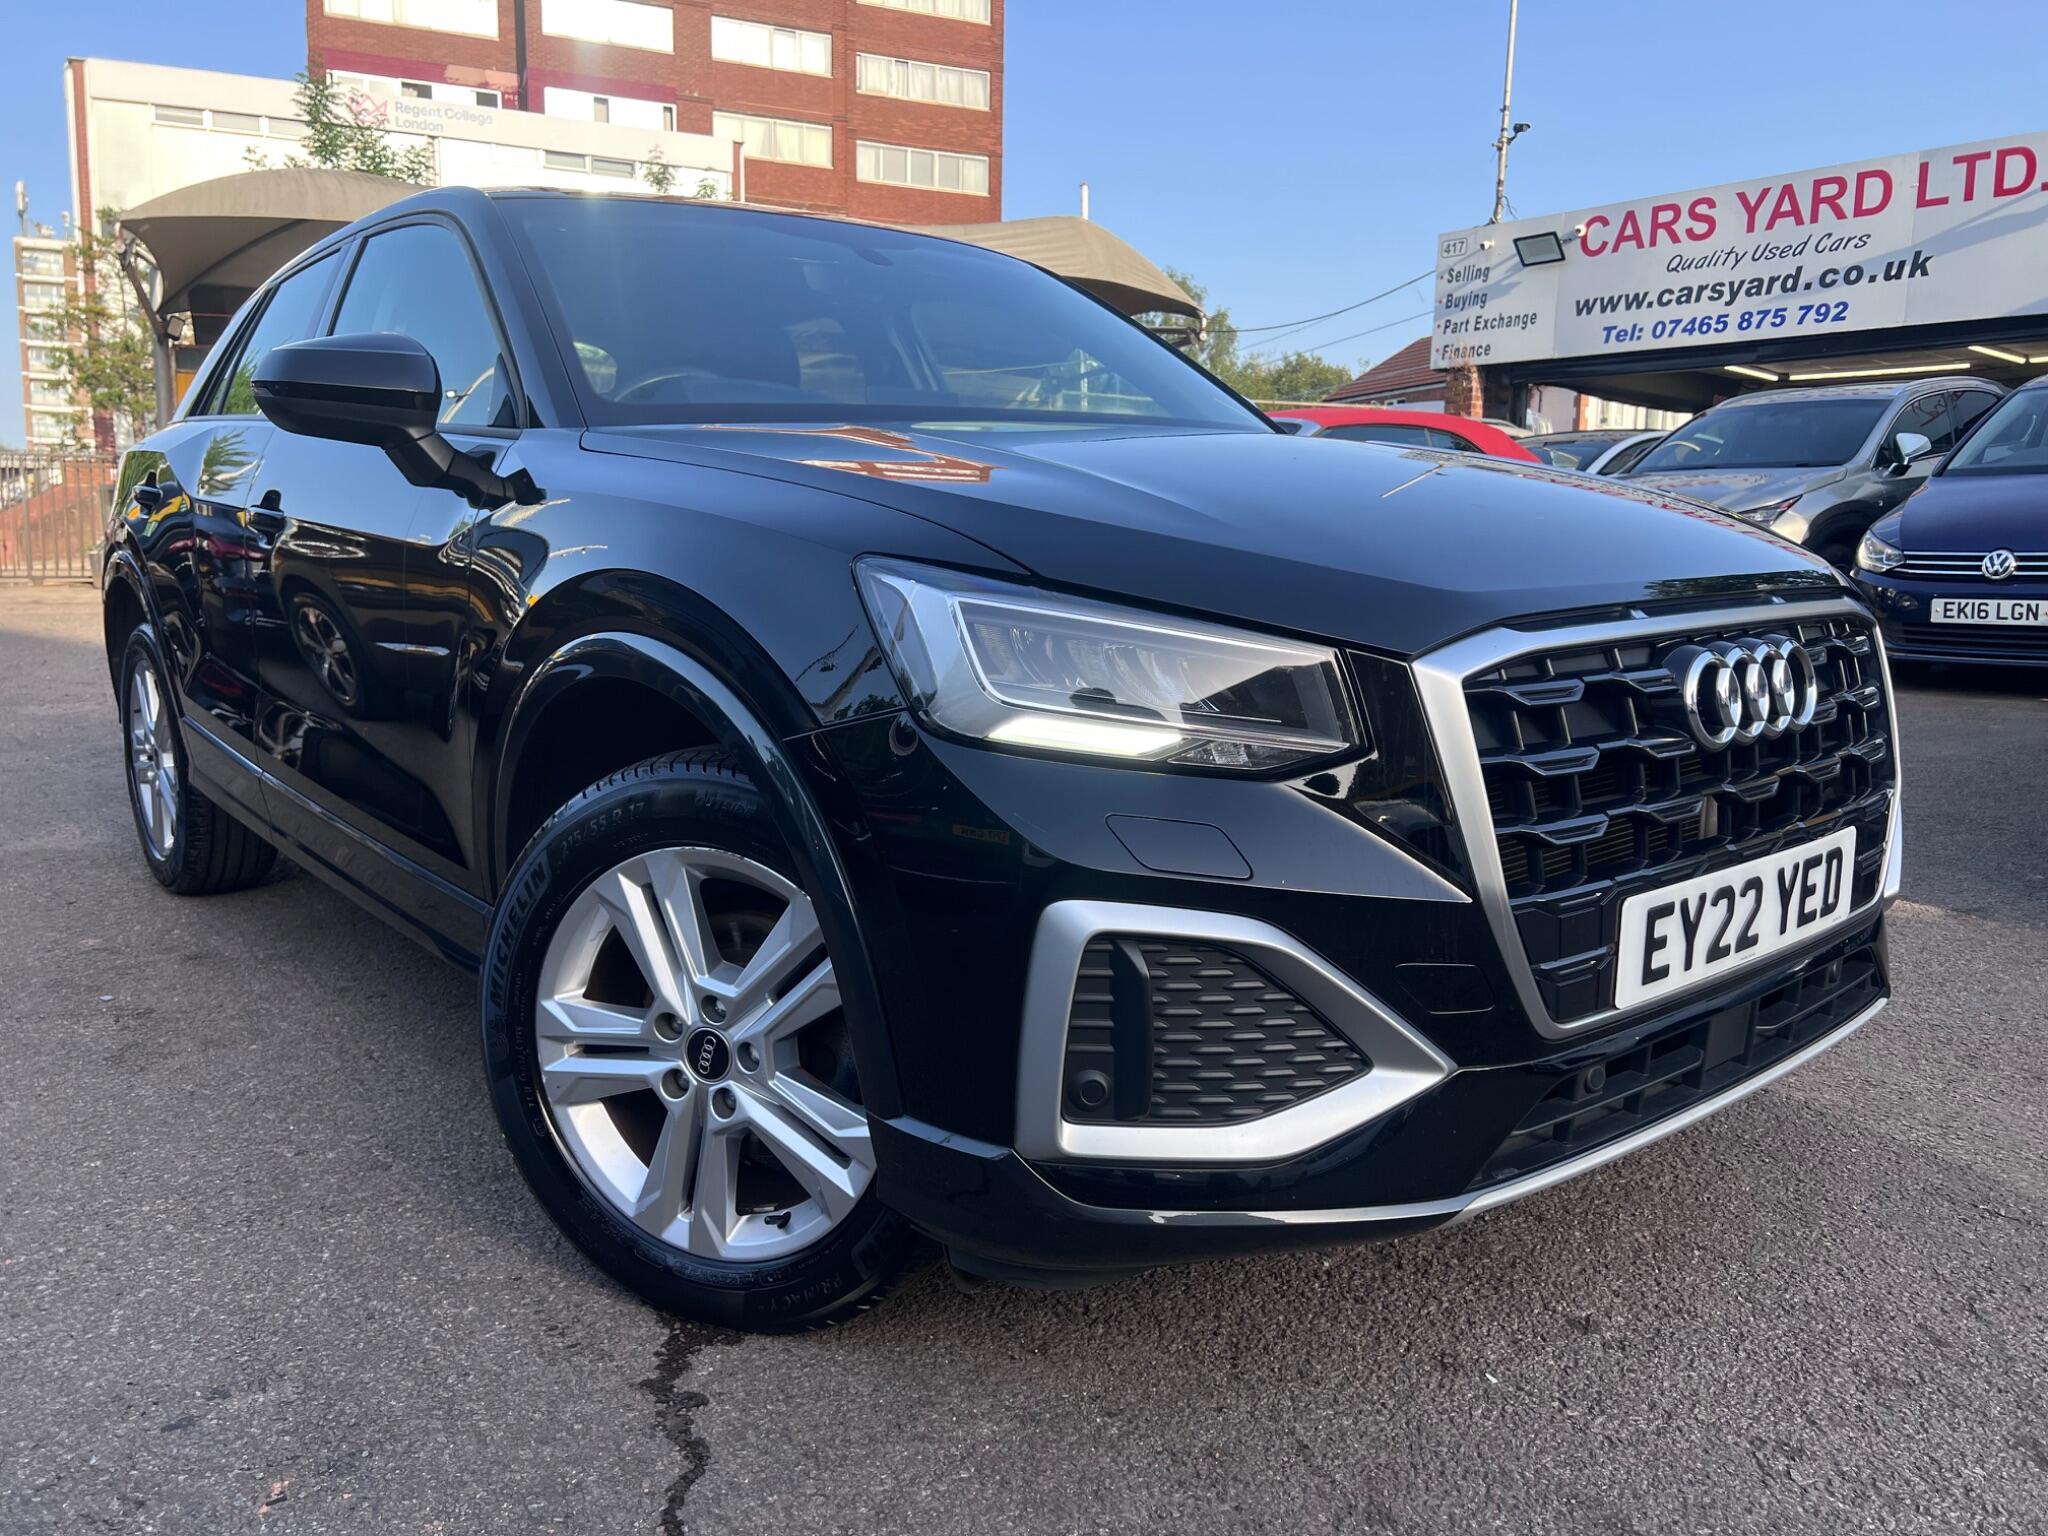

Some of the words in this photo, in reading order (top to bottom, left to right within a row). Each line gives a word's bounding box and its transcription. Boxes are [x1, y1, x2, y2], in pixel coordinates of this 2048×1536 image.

[395, 102, 442, 119] Regent
[444, 108, 493, 127] College
[395, 117, 444, 133] London
[1579, 196, 1718, 258] CARS
[1735, 169, 1894, 234] YARD
[1444, 241, 1465, 255] 417
[1665, 246, 1749, 274] Quality
[1751, 233, 1813, 262] Used
[1814, 231, 1872, 254] Cars
[1446, 264, 1490, 284] Selling
[1574, 249, 1935, 317] www.carsyard.co.uk
[1445, 290, 1488, 312] Buying
[1443, 318, 1469, 335] Part
[1473, 312, 1538, 332] Exchange
[1602, 322, 1644, 344] Tel:
[1651, 313, 1730, 340] 07465
[1737, 307, 1788, 332] 875
[1796, 300, 1850, 325] 792
[1441, 343, 1492, 361] Finance
[1942, 601, 1990, 620] EK16
[1995, 602, 2040, 621] LGN
[1641, 875, 1764, 987] EY22
[1776, 846, 1844, 937] YED
[489, 860, 547, 1009] MICHELIN
